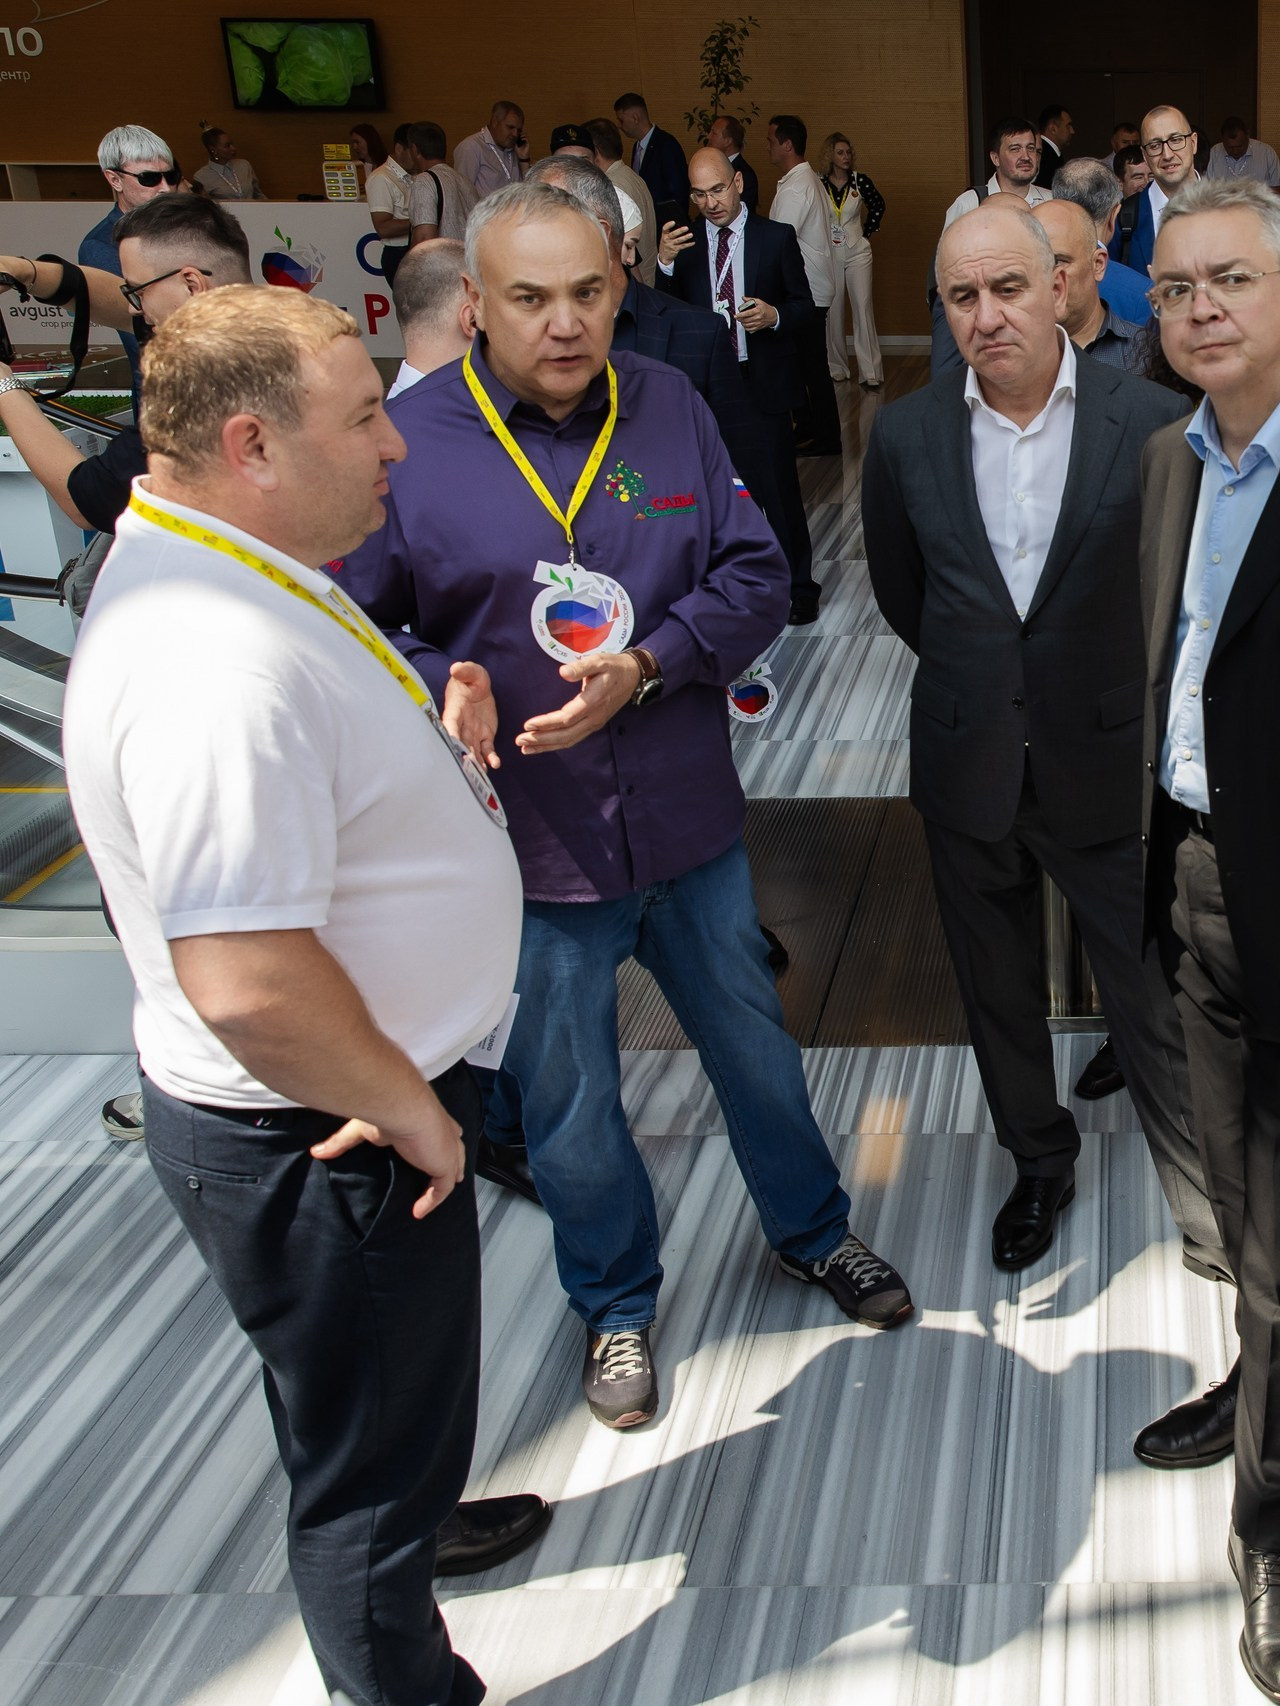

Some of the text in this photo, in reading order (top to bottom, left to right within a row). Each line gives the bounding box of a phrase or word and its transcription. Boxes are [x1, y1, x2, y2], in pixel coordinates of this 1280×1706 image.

[0, 70, 31, 83] ентр
[9, 305, 64, 321] avgust
[40, 321, 60, 329] crop
[651, 492, 696, 510] САДЫ
